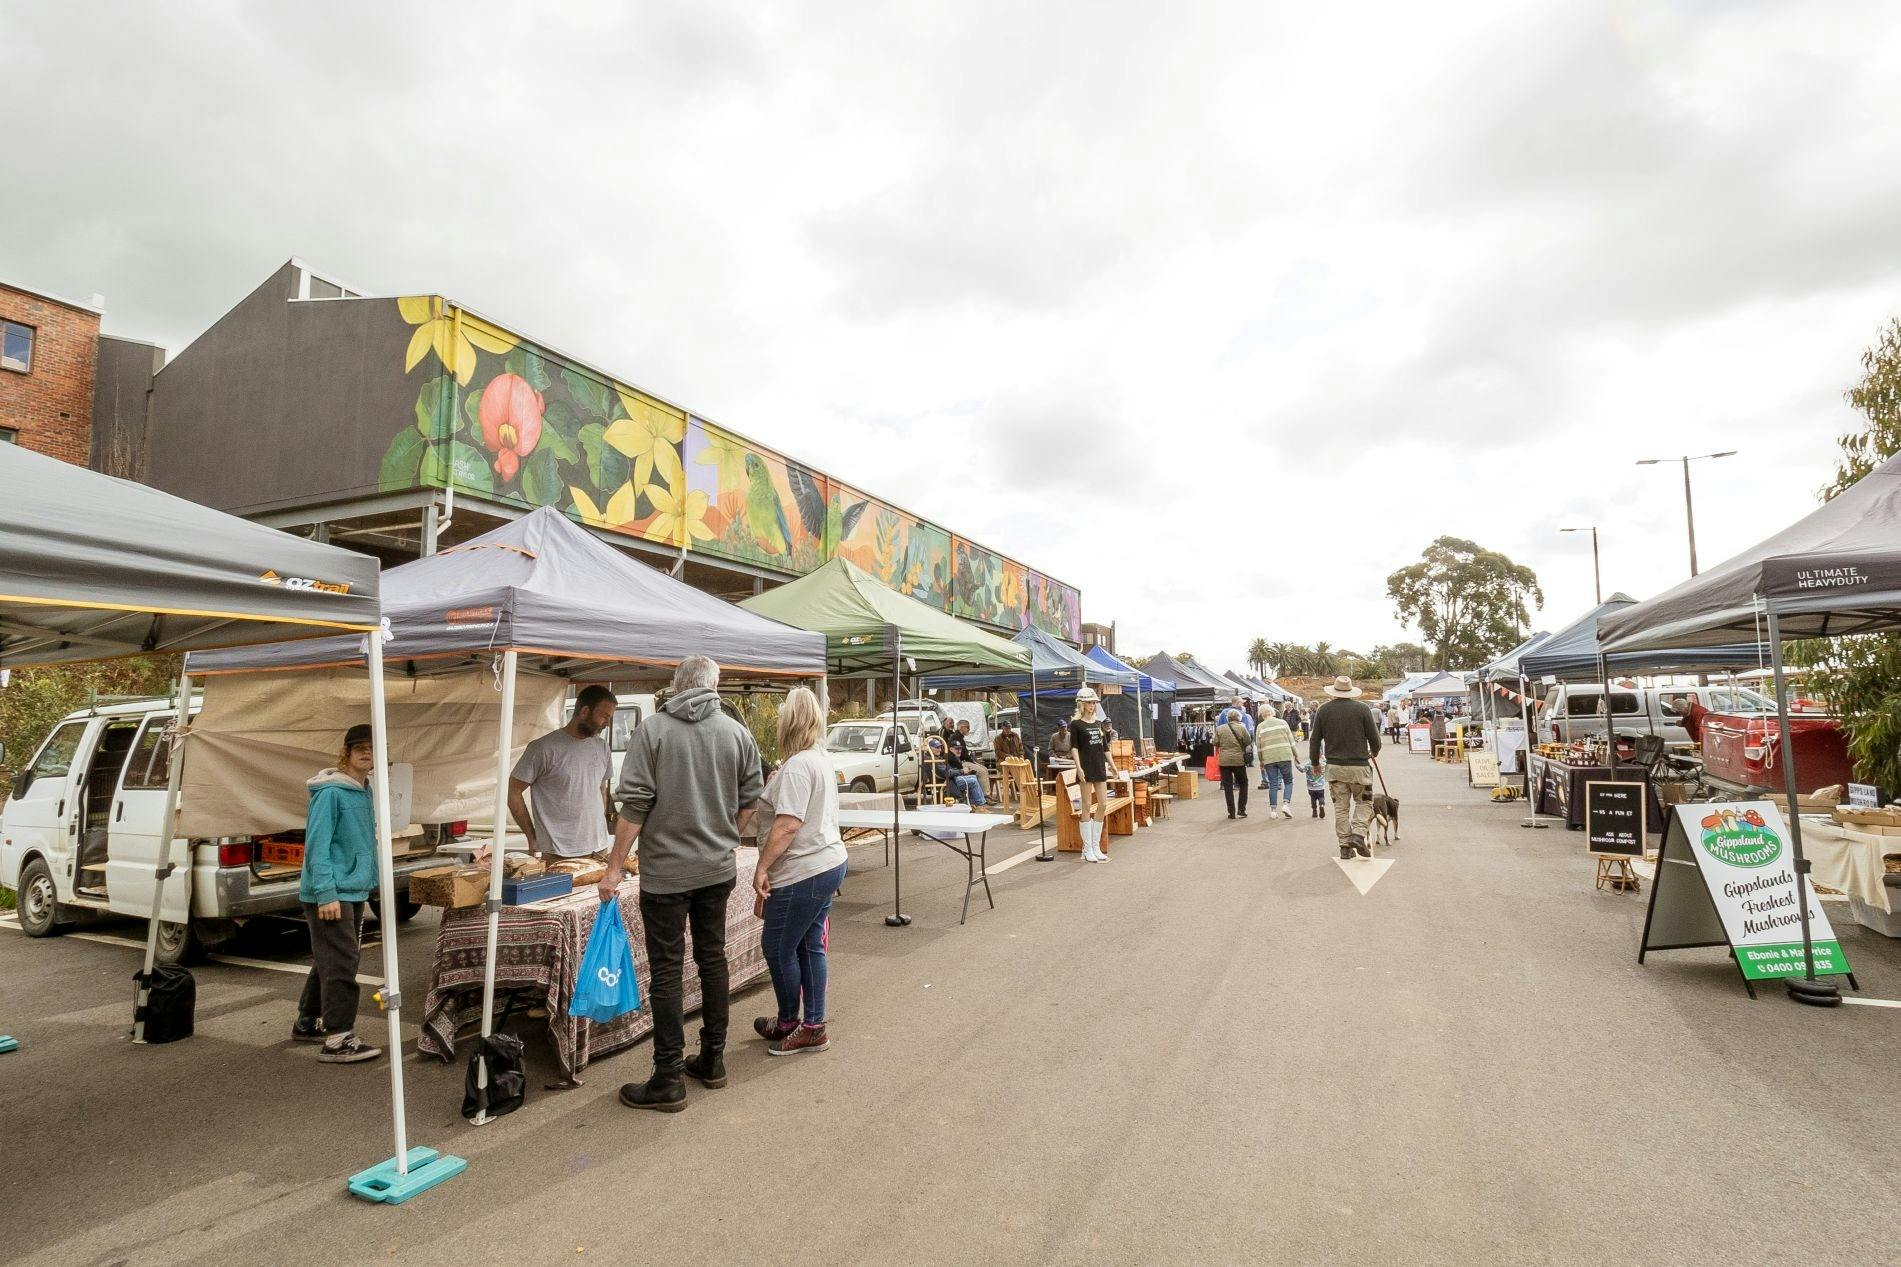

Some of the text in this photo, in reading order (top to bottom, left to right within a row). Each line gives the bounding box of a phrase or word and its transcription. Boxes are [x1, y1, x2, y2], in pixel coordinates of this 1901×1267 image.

[1797, 566, 1858, 579] ULTIMATE
[1798, 575, 1869, 588] HEAVYDUTY
[1716, 834, 1764, 849] Gippsland
[1710, 841, 1777, 864] MUSHROOMS
[1723, 869, 1794, 899] Gippslands
[1741, 890, 1796, 915] Freshest
[1746, 950, 1780, 960] Ebonie
[1781, 949, 1789, 958] &
[1766, 962, 1793, 973] 0400
